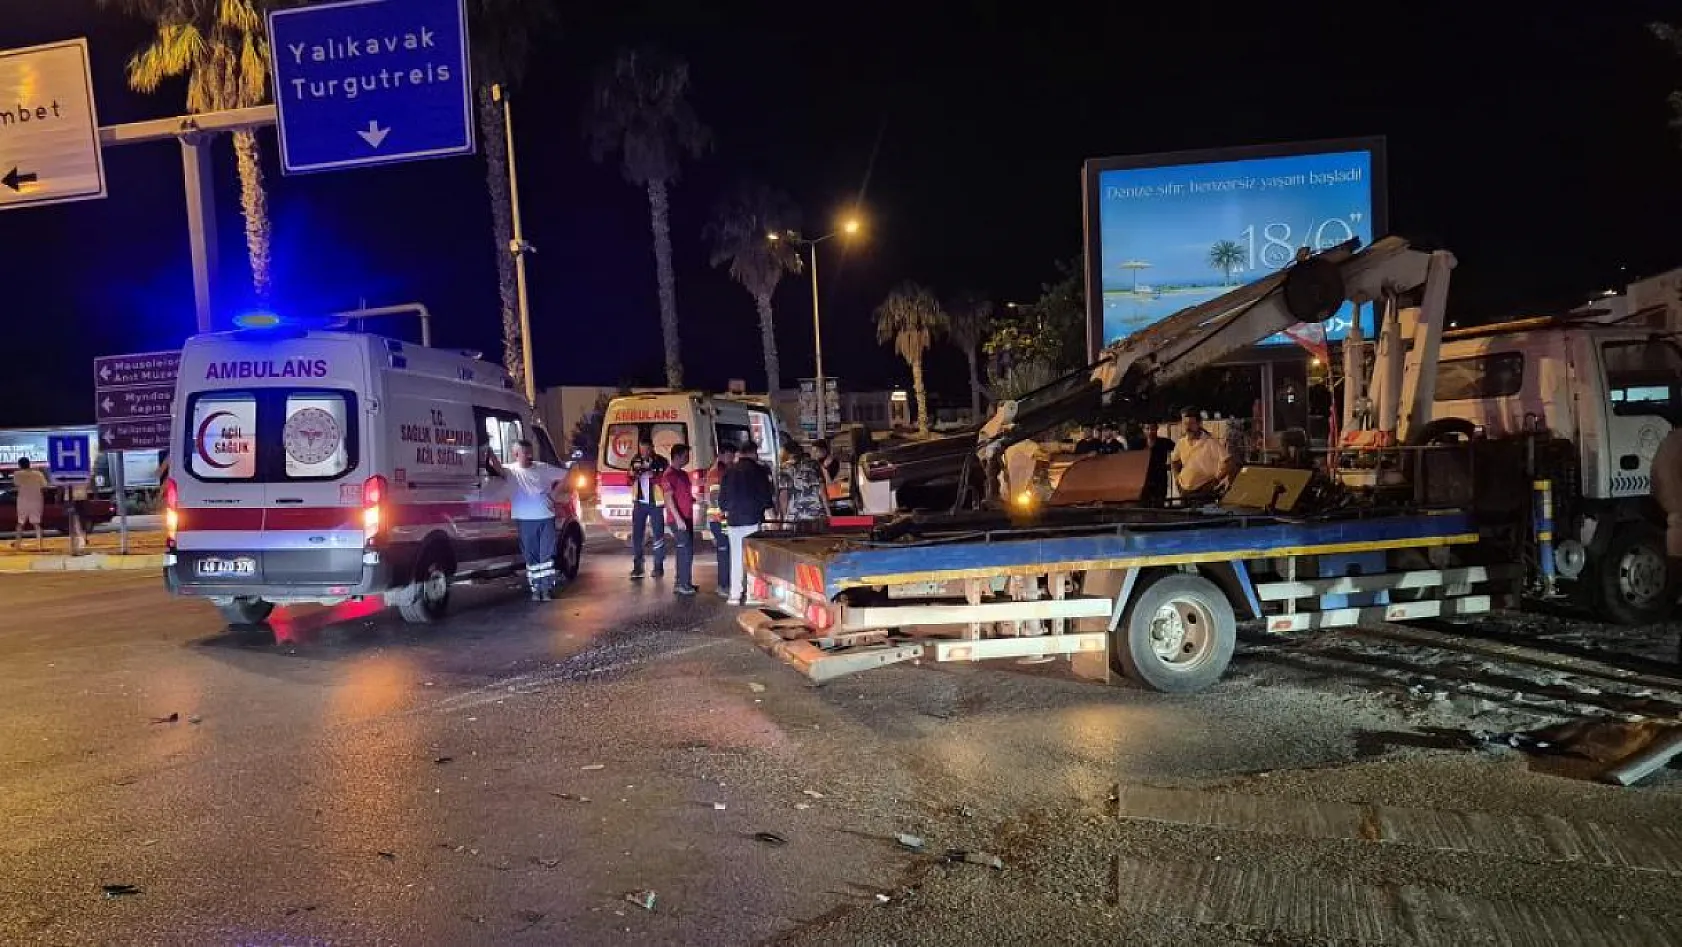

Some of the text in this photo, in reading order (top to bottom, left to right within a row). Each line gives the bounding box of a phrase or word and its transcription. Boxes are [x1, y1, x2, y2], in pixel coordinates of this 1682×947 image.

[288, 26, 435, 65] Yalıkavak
[292, 63, 450, 100] Turgutreis
[205, 359, 327, 379] AMBULANS
[57, 439, 81, 468] H
